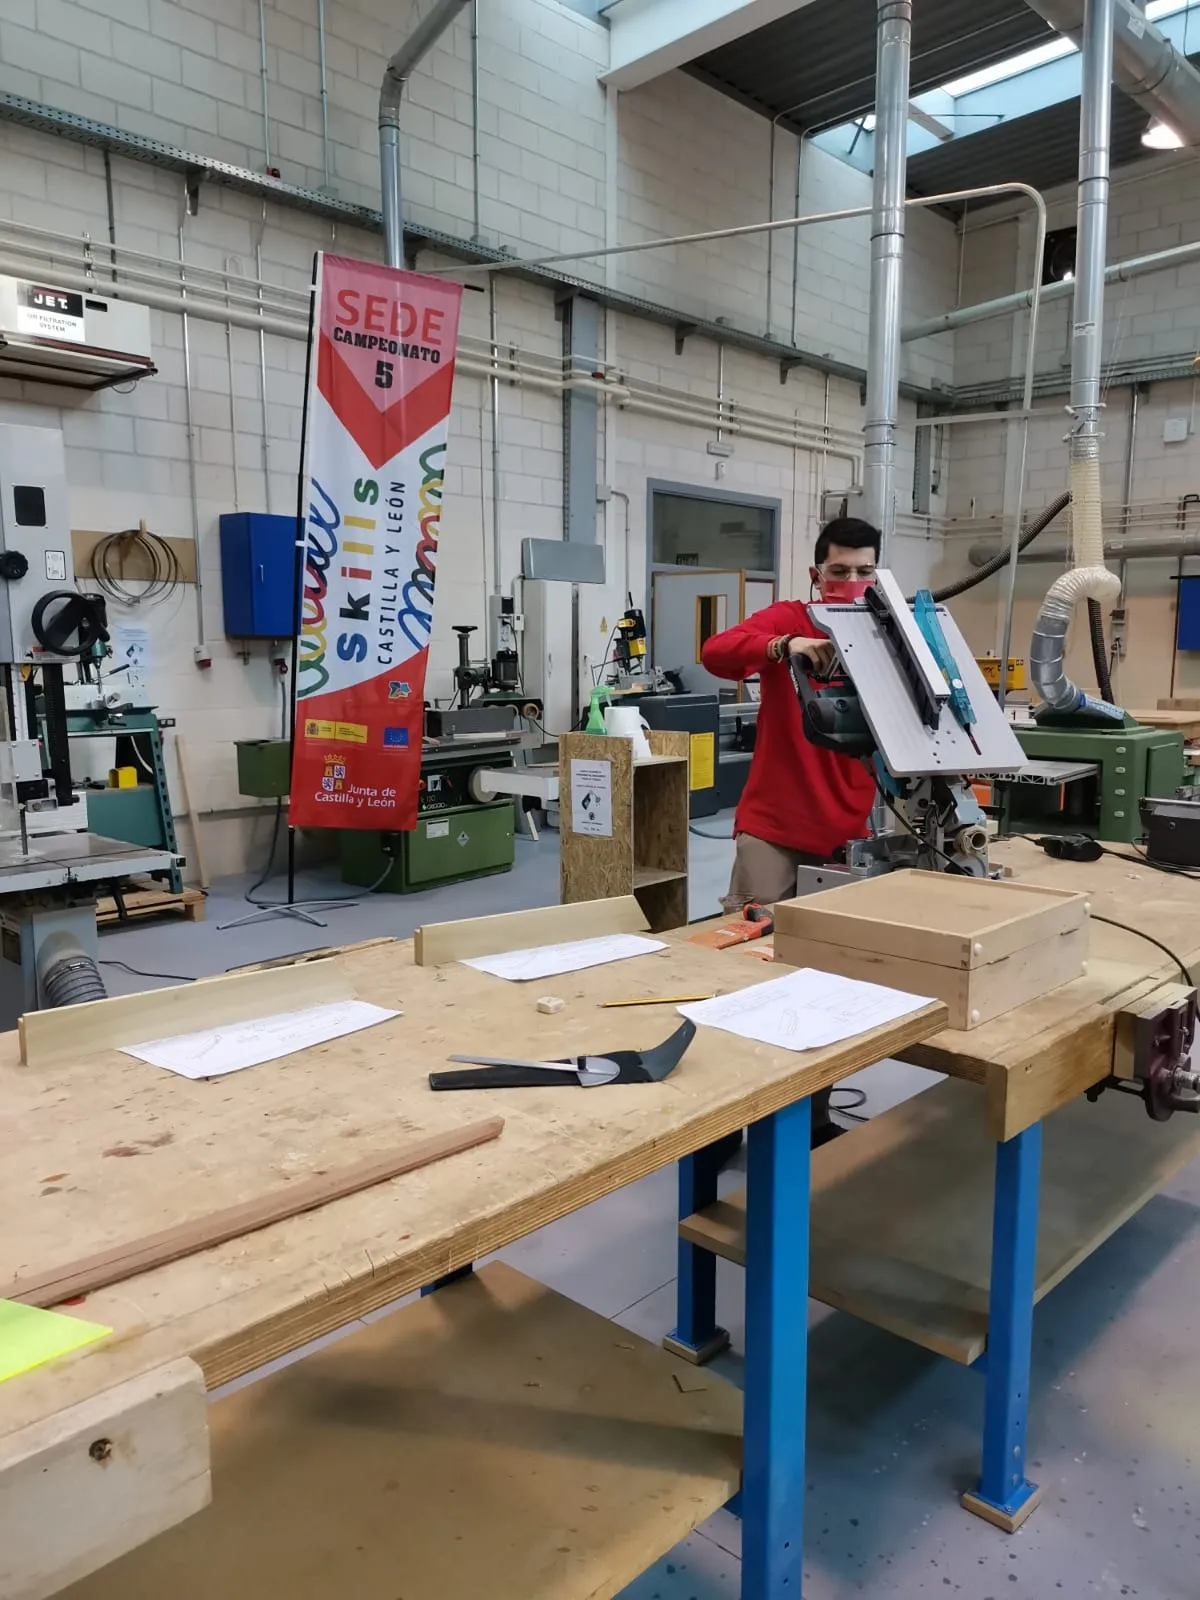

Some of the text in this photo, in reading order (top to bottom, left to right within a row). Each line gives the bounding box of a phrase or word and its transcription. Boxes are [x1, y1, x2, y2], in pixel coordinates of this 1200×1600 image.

[336, 289, 444, 345] SEDE
[333, 327, 441, 364] CAMPEONATO
[375, 360, 394, 389] 5
[336, 478, 379, 663] skills
[378, 481, 406, 665] CASTILLA Y LEÓN
[314, 791, 396, 808] Castilla y León
[347, 784, 396, 797] Junta de
